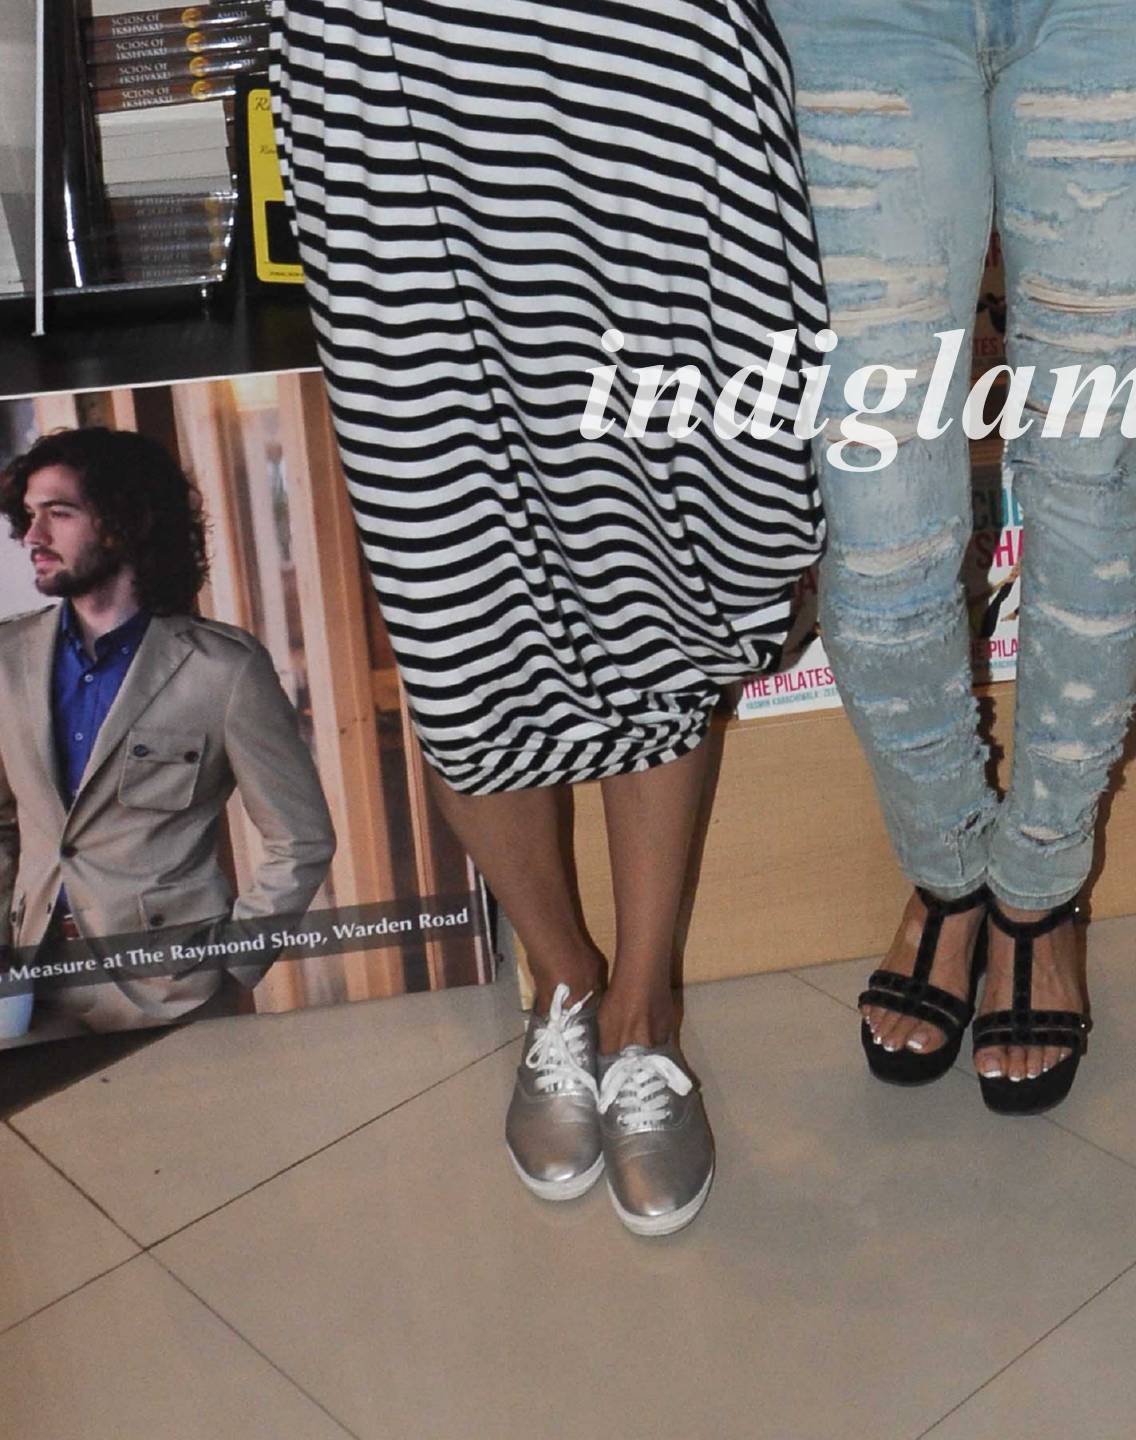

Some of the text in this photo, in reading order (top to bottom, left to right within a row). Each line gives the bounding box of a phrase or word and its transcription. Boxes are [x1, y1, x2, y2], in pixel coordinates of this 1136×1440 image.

[112, 13, 160, 26] SCION OF
[116, 38, 164, 51] SCION OF
[119, 62, 168, 75] SCION OF
[122, 87, 170, 100] SCION OF
[988, 639, 1019, 660] PILA
[741, 667, 836, 700] THE PILATES
[8, 907, 470, 983] Measure at The Raymond Shop, Warden Road
